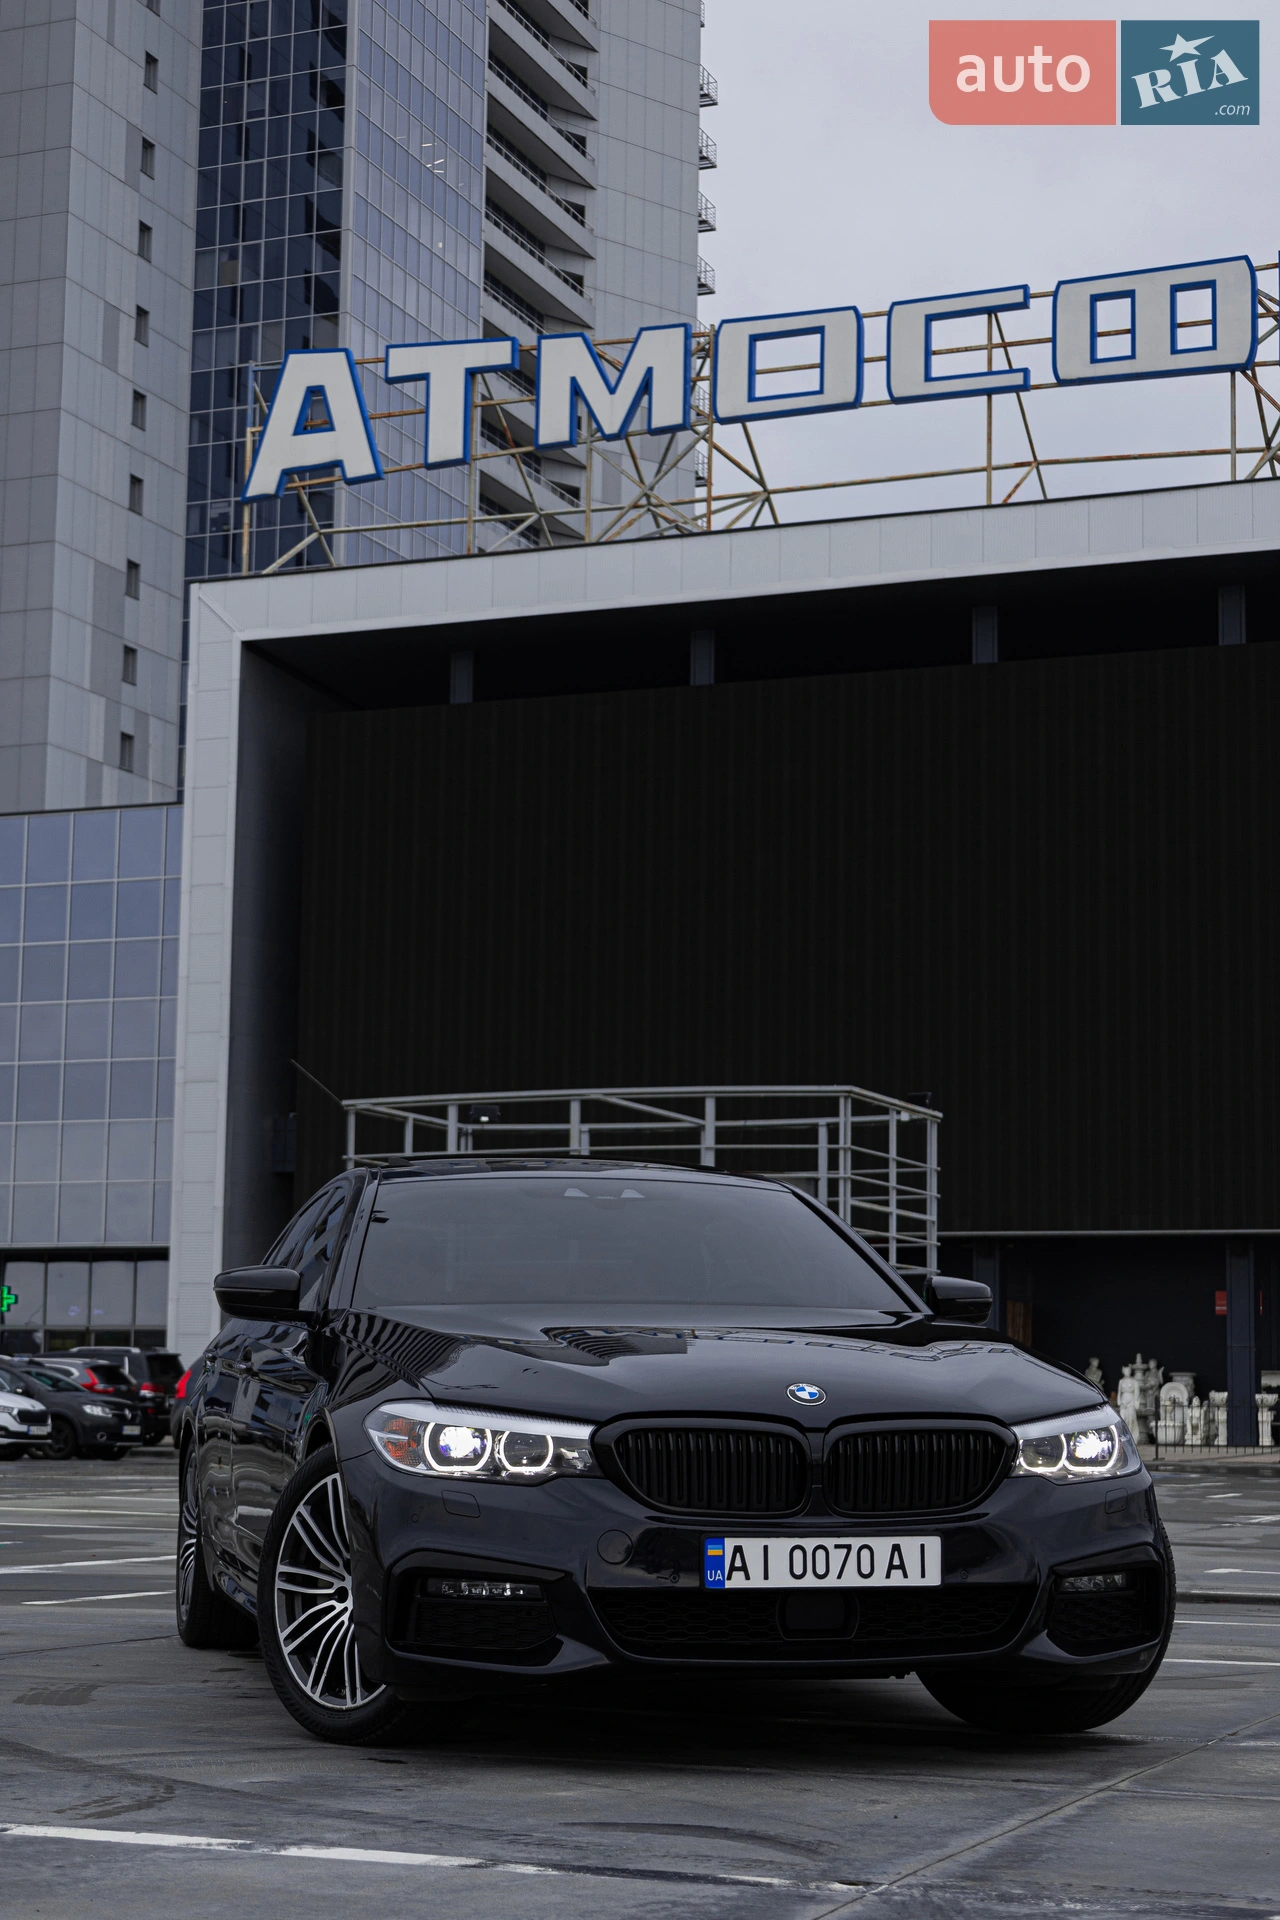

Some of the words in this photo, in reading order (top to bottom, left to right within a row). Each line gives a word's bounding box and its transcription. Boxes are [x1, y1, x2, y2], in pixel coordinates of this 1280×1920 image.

[241, 250, 1280, 501] АТМОСФ
[707, 1569, 724, 1581] UA
[726, 1544, 770, 1581] AI
[788, 1543, 875, 1580] 0070
[885, 1543, 926, 1579] AI
